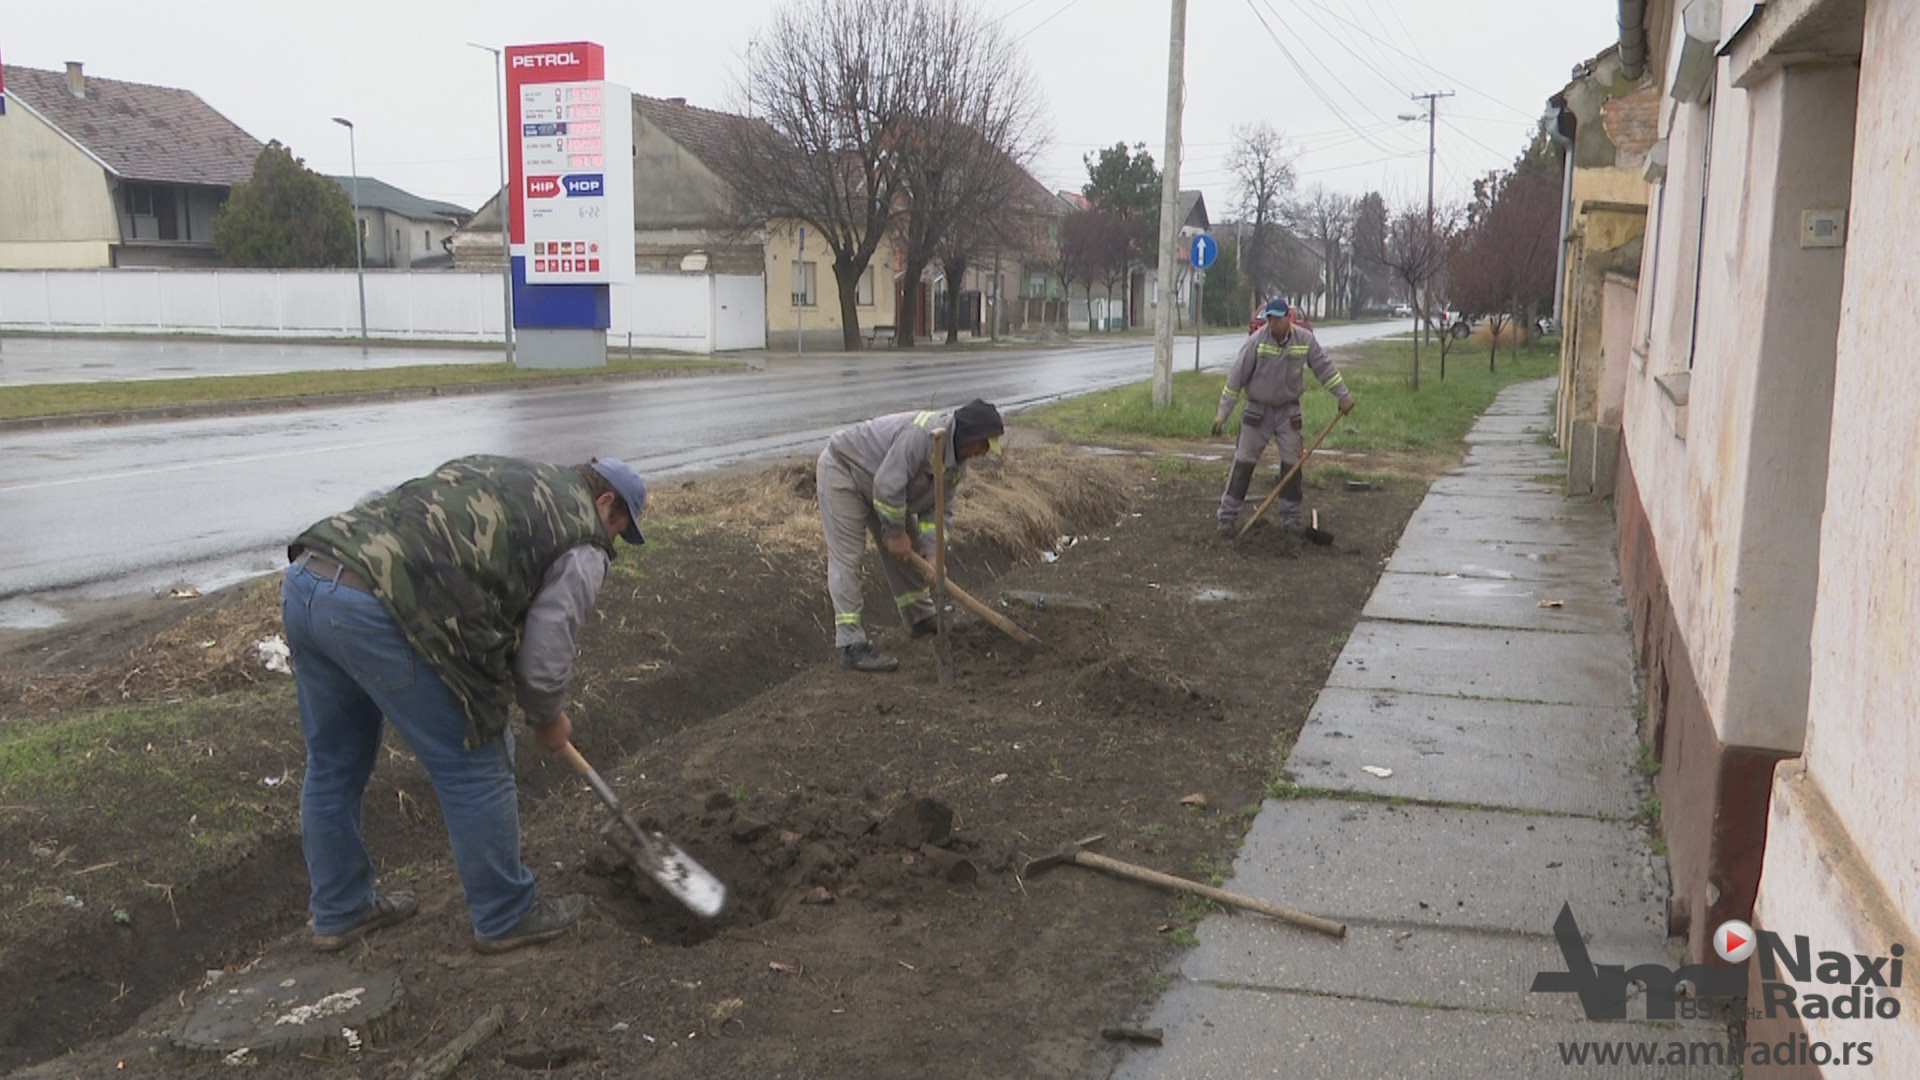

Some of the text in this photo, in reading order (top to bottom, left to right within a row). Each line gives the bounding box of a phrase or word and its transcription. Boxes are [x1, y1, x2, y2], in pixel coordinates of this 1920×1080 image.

[512, 52, 580, 69] PETROL
[530, 181, 600, 193] HIP HOP
